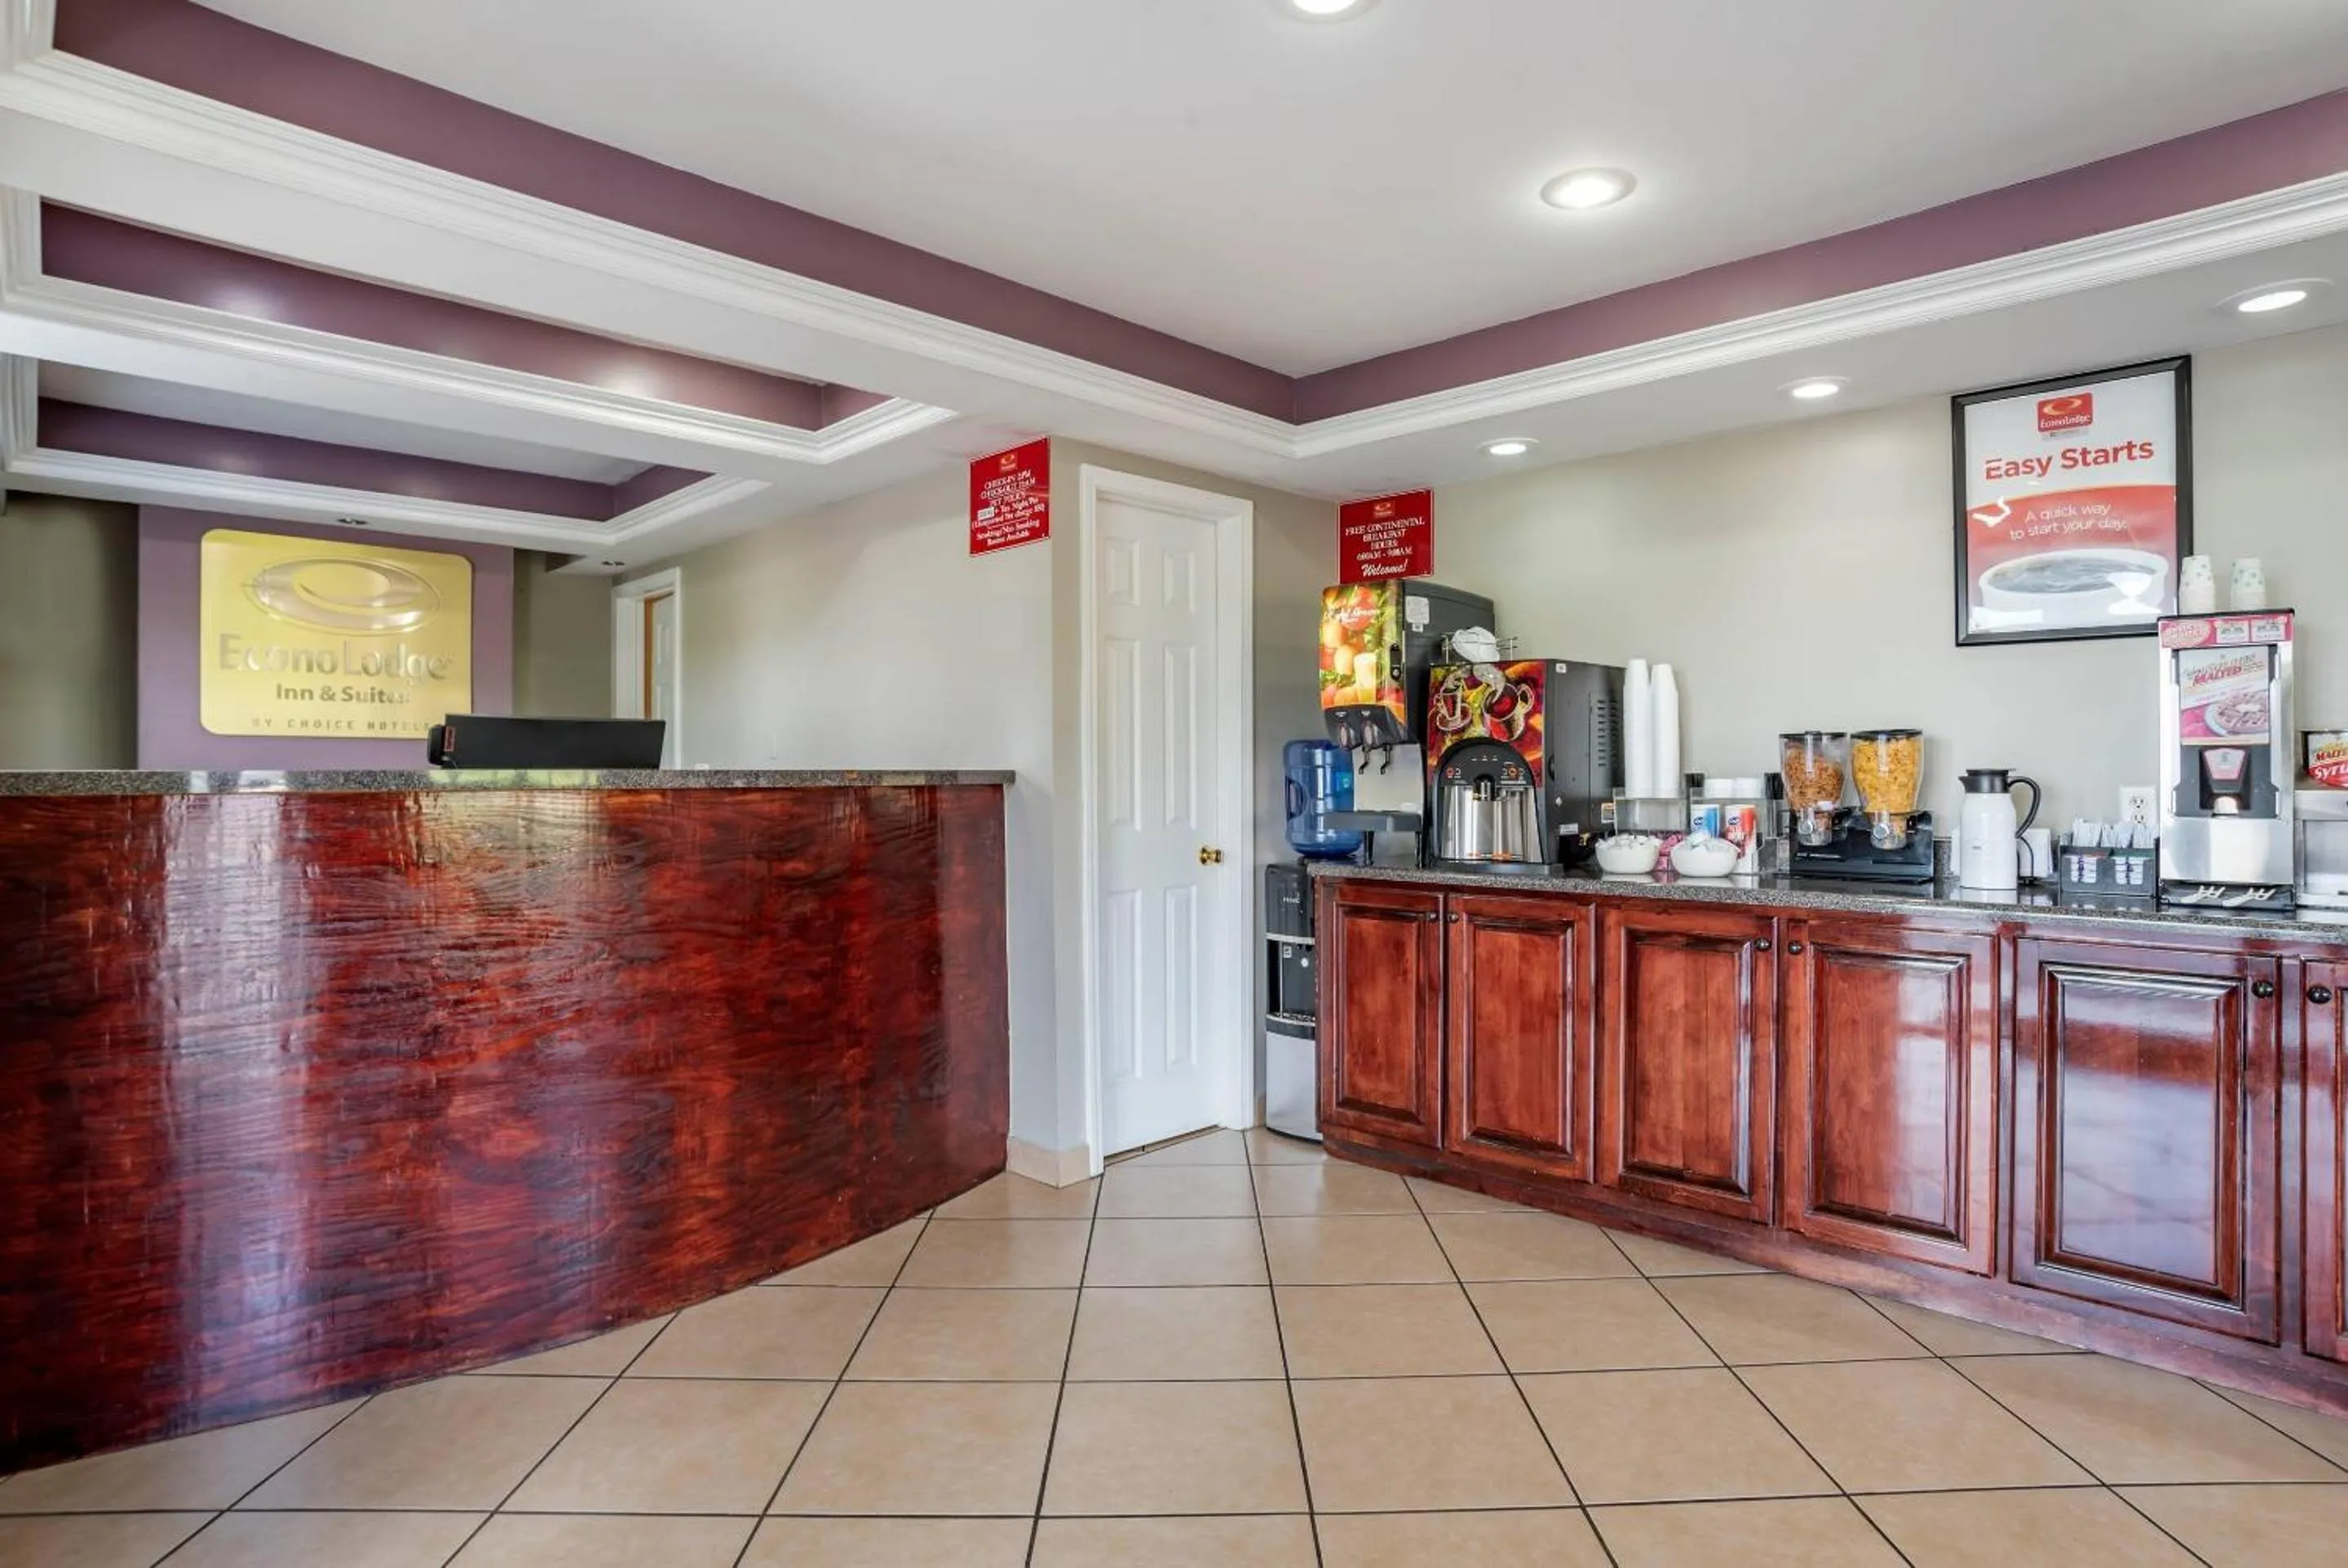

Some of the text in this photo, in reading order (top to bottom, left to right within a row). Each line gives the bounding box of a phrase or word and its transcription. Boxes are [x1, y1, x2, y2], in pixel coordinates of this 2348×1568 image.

[1985, 440, 2154, 480] Easy Starts
[2026, 503, 2111, 523] A quick way
[1366, 516, 1425, 532] CONTINENTAL
[2010, 530, 2024, 541] to
[2027, 521, 2060, 536] start
[2063, 517, 2094, 534] your
[1361, 559, 1408, 577] Welcome!
[276, 683, 314, 700] Inn
[321, 687, 336, 702] &
[287, 719, 355, 731] CHOICE
